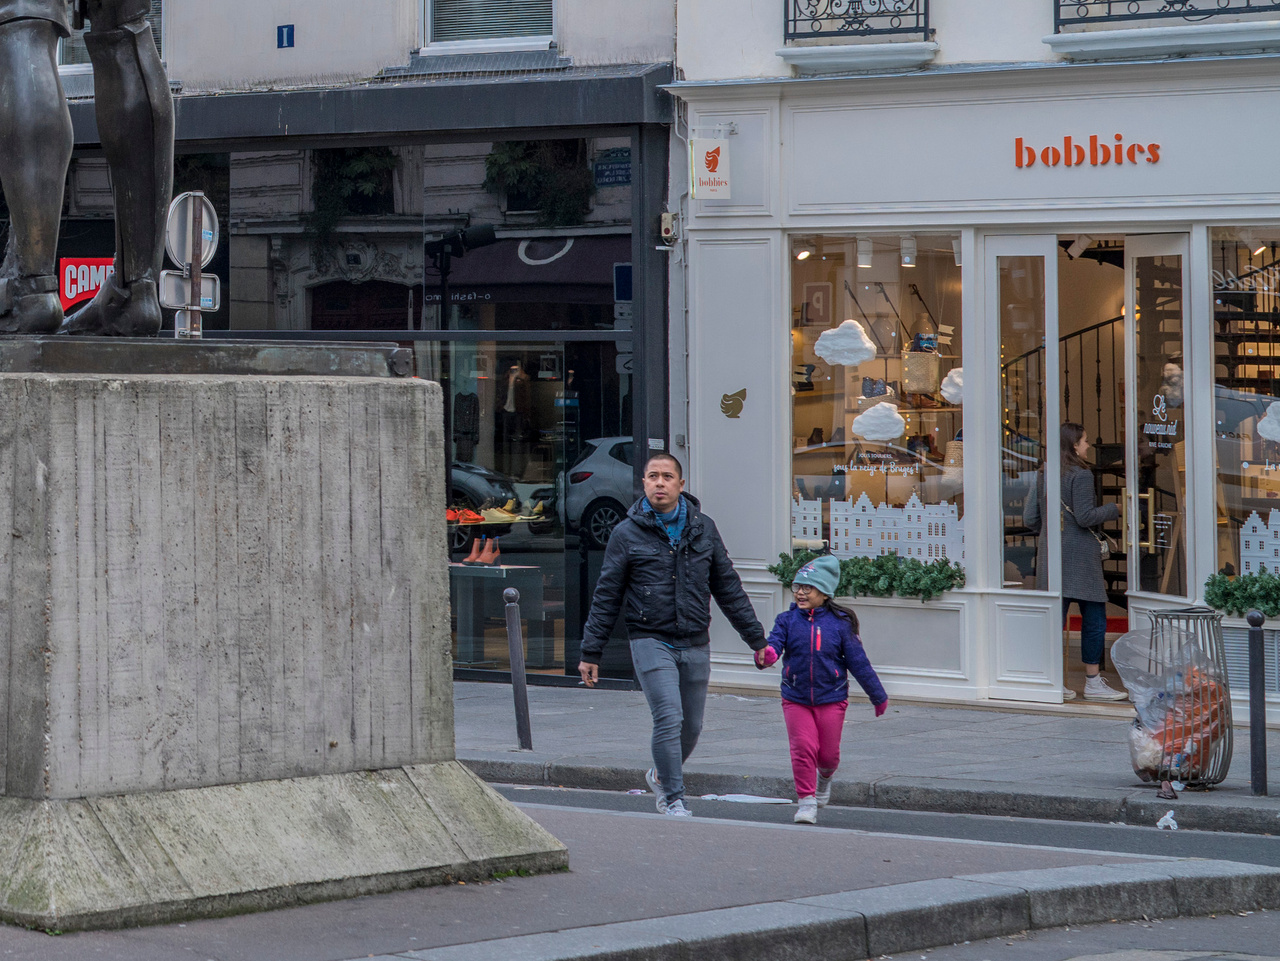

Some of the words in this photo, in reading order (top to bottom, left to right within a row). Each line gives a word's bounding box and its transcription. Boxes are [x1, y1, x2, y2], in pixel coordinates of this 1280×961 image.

[1015, 133, 1161, 168] bobbies
[699, 177, 728, 187] bobbies
[833, 464, 848, 473] sous
[850, 460, 858, 471] la
[860, 464, 877, 476] neige
[879, 461, 887, 474] de
[889, 462, 914, 477] Bruges
